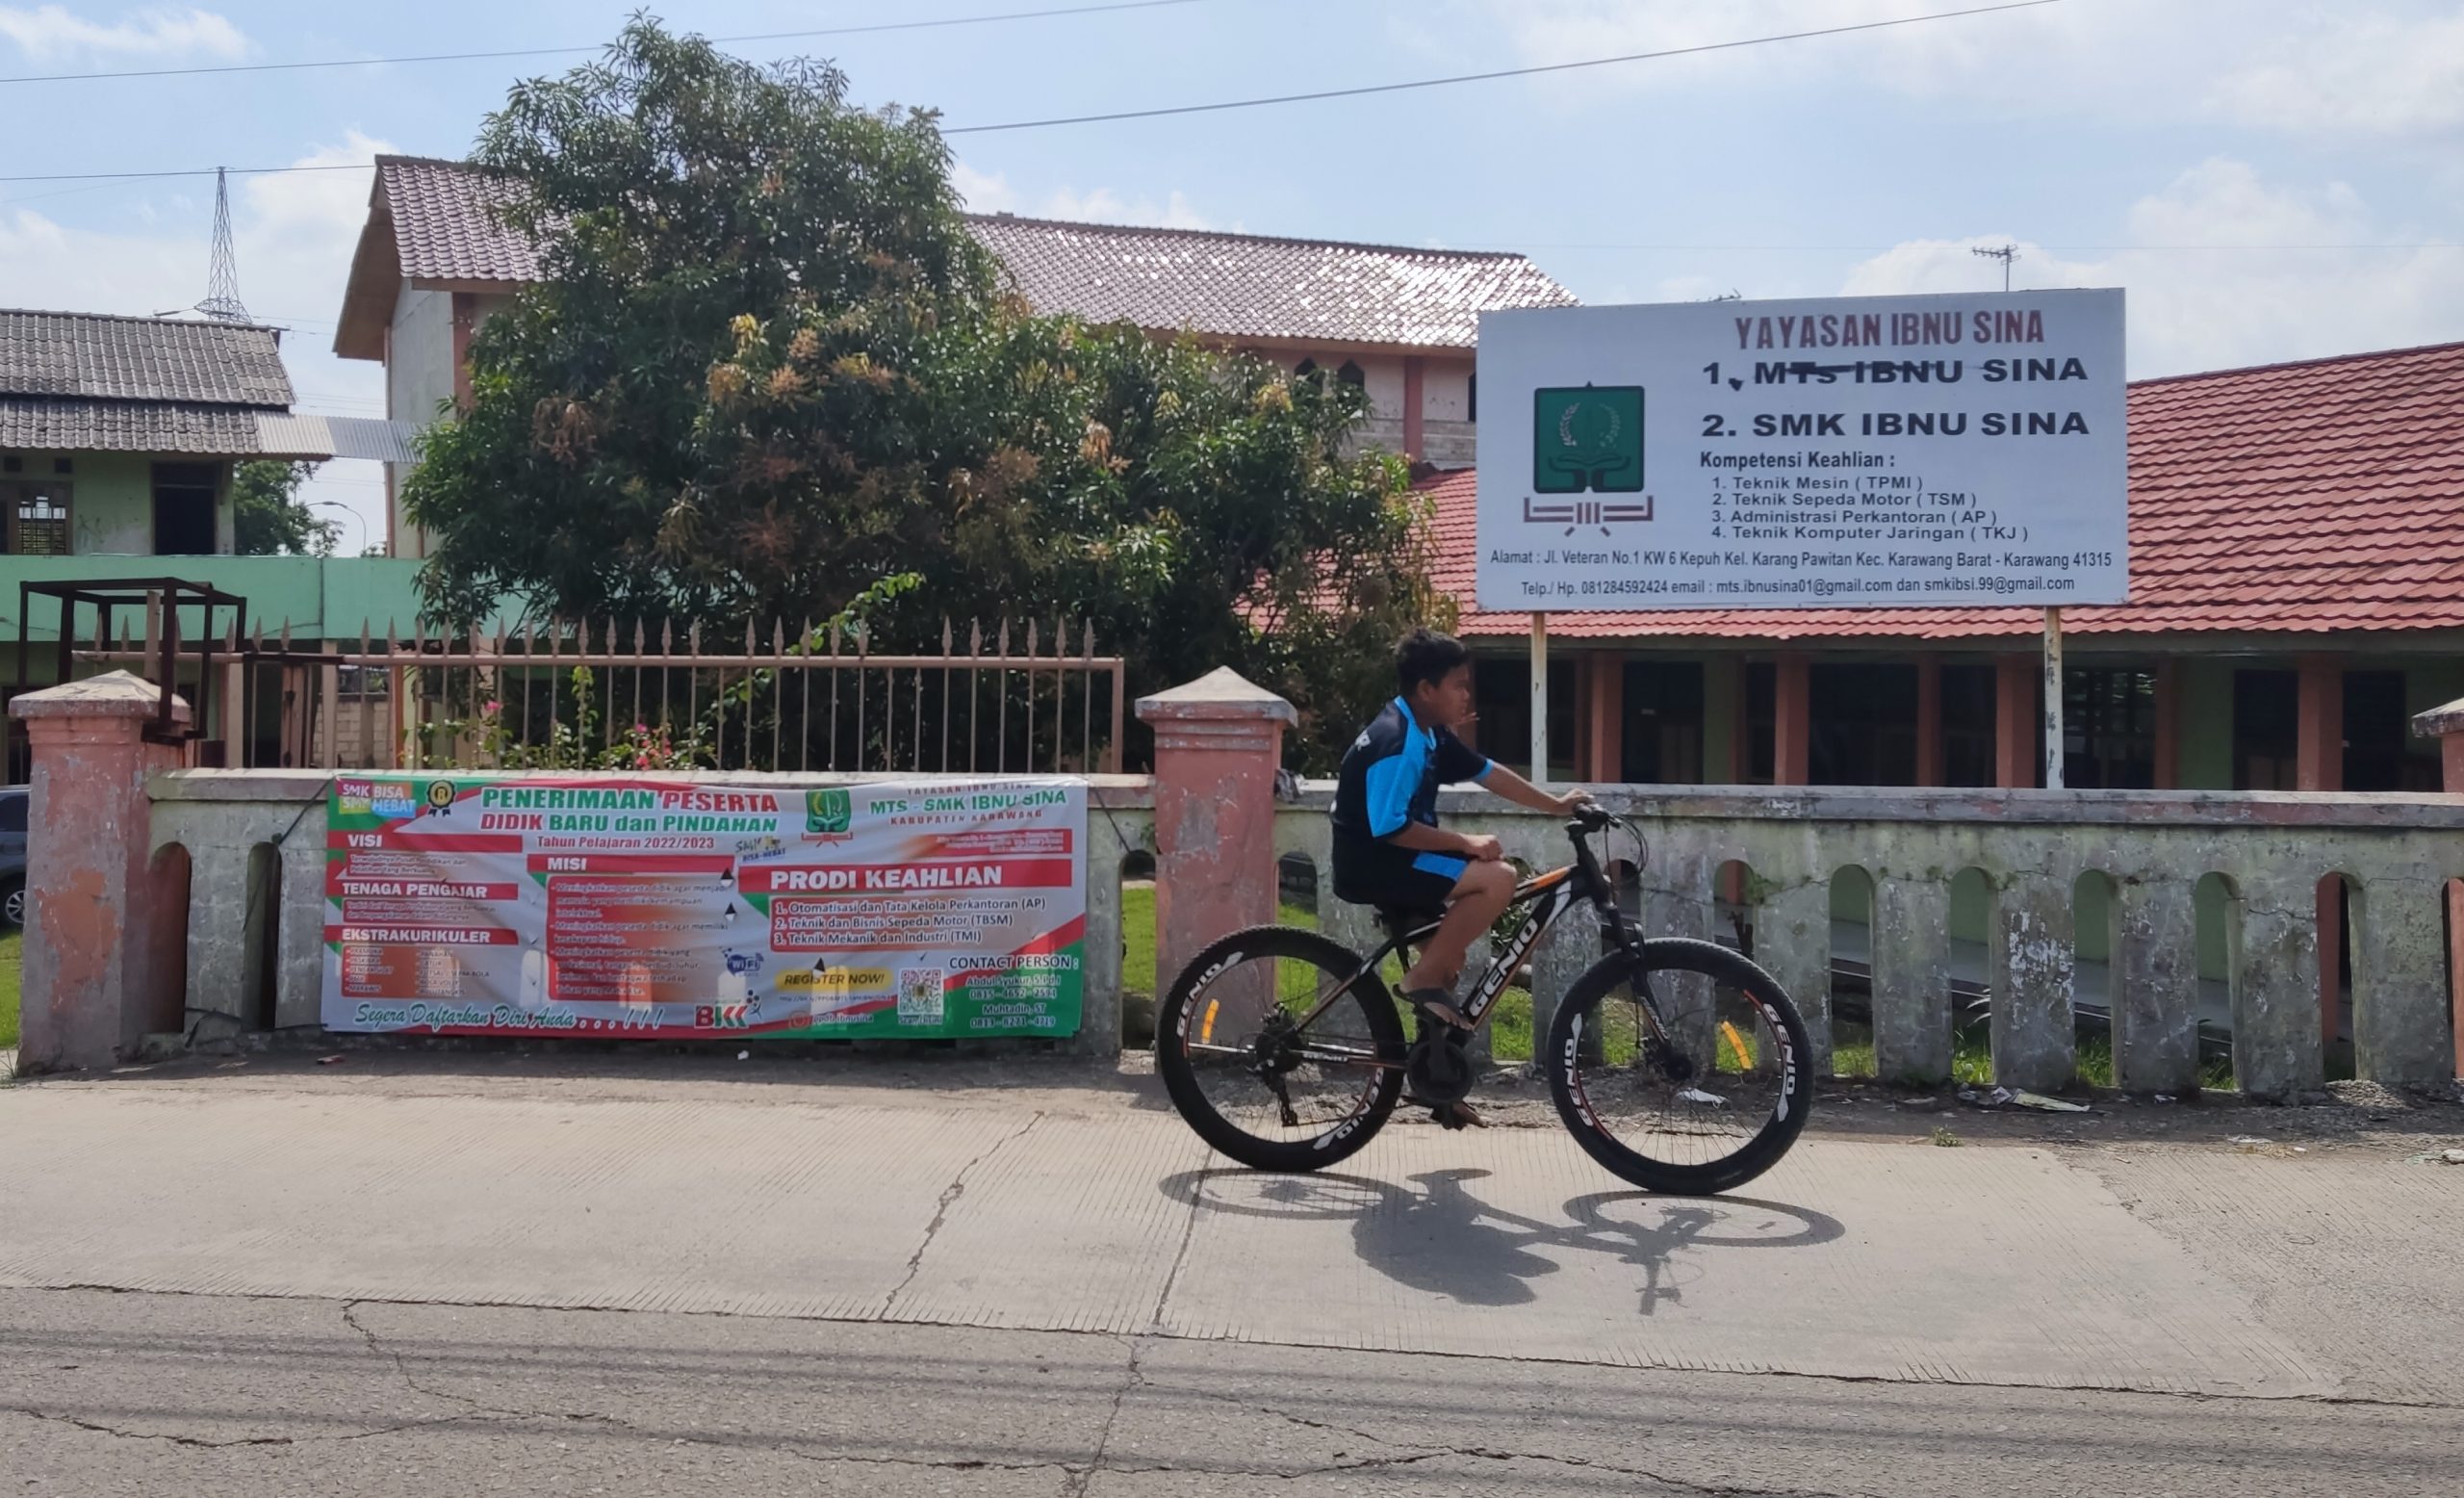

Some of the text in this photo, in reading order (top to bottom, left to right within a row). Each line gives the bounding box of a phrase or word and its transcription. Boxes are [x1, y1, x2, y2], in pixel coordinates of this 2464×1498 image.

[1734, 309, 2044, 349] YAYASAN IBNU SINA
[1755, 361, 1837, 384] MTs
[1855, 360, 1964, 383] IBNU
[1983, 358, 2088, 381] SINA
[1702, 412, 2090, 436] 2. SMK IBNU SINA
[1700, 451, 1802, 471] Kompetensi
[1809, 451, 1884, 468] Keahlian
[1712, 477, 1911, 489] 1. Teknik Mesin TPMI
[1712, 493, 1965, 509] 2. Teknik Sepeda Motor TSM
[1712, 510, 1987, 524] 3. Administrasi Perkantoran AP
[1712, 527, 2016, 542] 4. Teknik Komputer Jaringan TKJ
[1491, 550, 2111, 570] Alamat Jl. Veteran No.1 KW 6 Kepuh Kel. Karang Pawitan Kec. Karawang Barat Karawang 41315
[1557, 581, 1578, 597] Hp.
[1581, 581, 1668, 594] 081284592424
[1672, 580, 1705, 593] email
[1716, 579, 1892, 596] mts.ibnusina01@gmail.com
[1896, 578, 1920, 592] dan
[343, 784, 403, 798] SMK BISA
[482, 788, 779, 813] PENERIMAAN PESERTA
[870, 790, 1066, 815] MTS SMK IBNU SINA
[481, 814, 777, 832] DIDIK BARU dan PINDAHAN
[348, 835, 382, 847] VISI
[538, 836, 714, 849] Tahun Pelajaran 2022/2023
[547, 857, 586, 871] MISI
[771, 866, 1001, 890] PRODI KEAHLIAN
[343, 883, 487, 898] TENAGA PENGAJAR
[776, 897, 1045, 914] 1. Otomatisasi dan Tata Kelola Perkantoran (AP)
[776, 915, 1013, 930] 2. Teknik dan Bisnis Sepeda Motor (TBSM)
[343, 929, 490, 943] EKSTRAKURIKULER
[775, 930, 982, 944] 3. Teknik Mekanik dan Industri (TMI)
[949, 957, 1014, 969] CONTACT
[1017, 956, 1070, 969] PERSON
[1469, 917, 1539, 1017] GENIO
[784, 973, 886, 986] REGISTER NOW!
[1176, 963, 1222, 1038] GENIO
[354, 1003, 577, 1031] Segera Daftarkan Diri Anda
[1763, 1003, 1796, 1097] GENIO
[1564, 1038, 1595, 1127] GENIO
